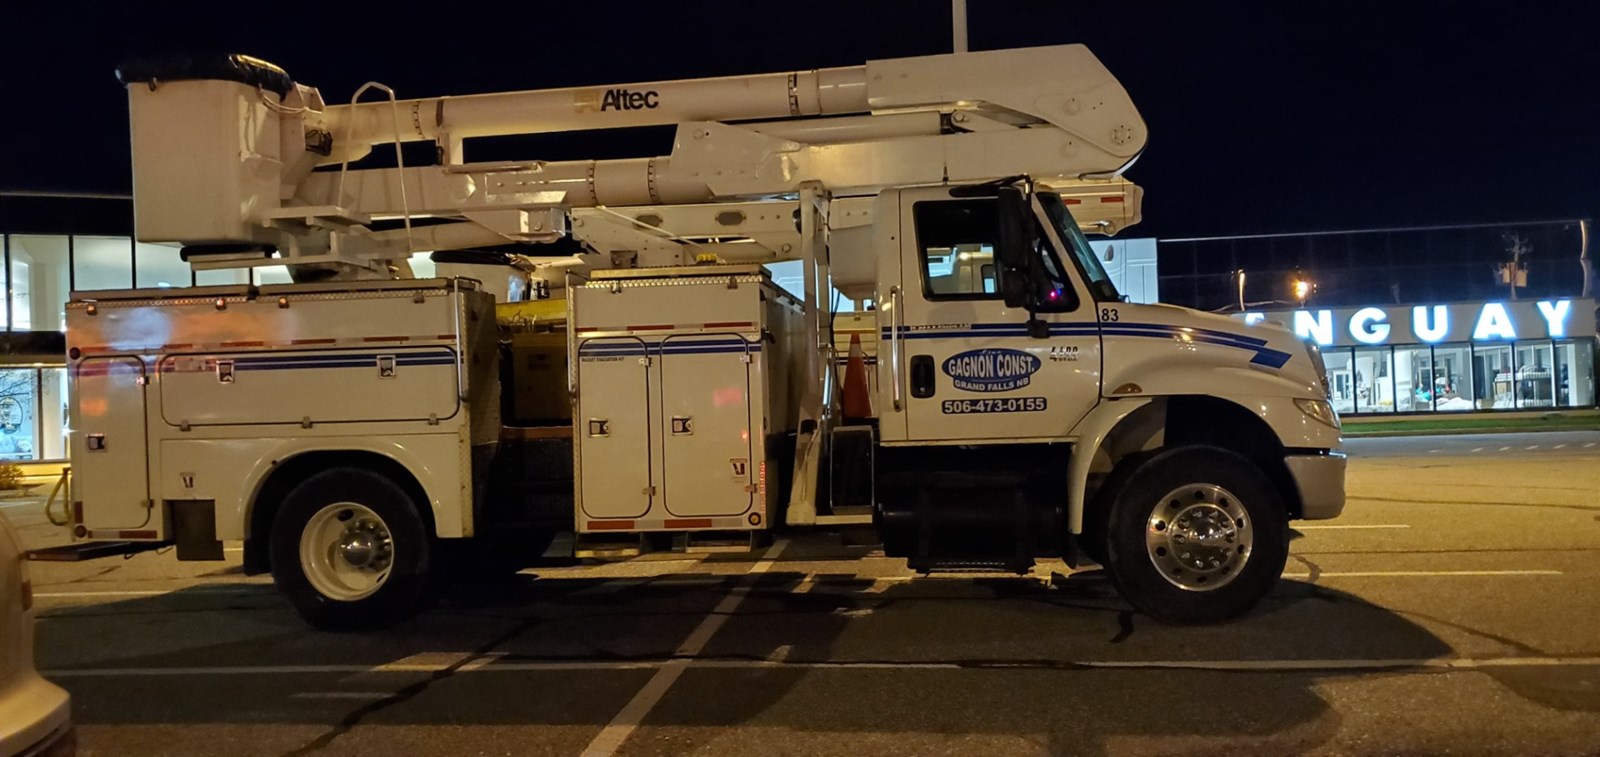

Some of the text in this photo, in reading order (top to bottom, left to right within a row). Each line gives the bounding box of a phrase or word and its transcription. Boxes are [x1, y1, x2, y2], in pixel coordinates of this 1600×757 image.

[601, 89, 659, 111] Altec
[1101, 308, 1119, 321] 83
[1245, 300, 1571, 346] NGUAY
[948, 355, 1035, 378] GAGNON CONST.
[954, 377, 1029, 391] GRAND FALLS NB
[944, 399, 1045, 413] 506-473-0155
